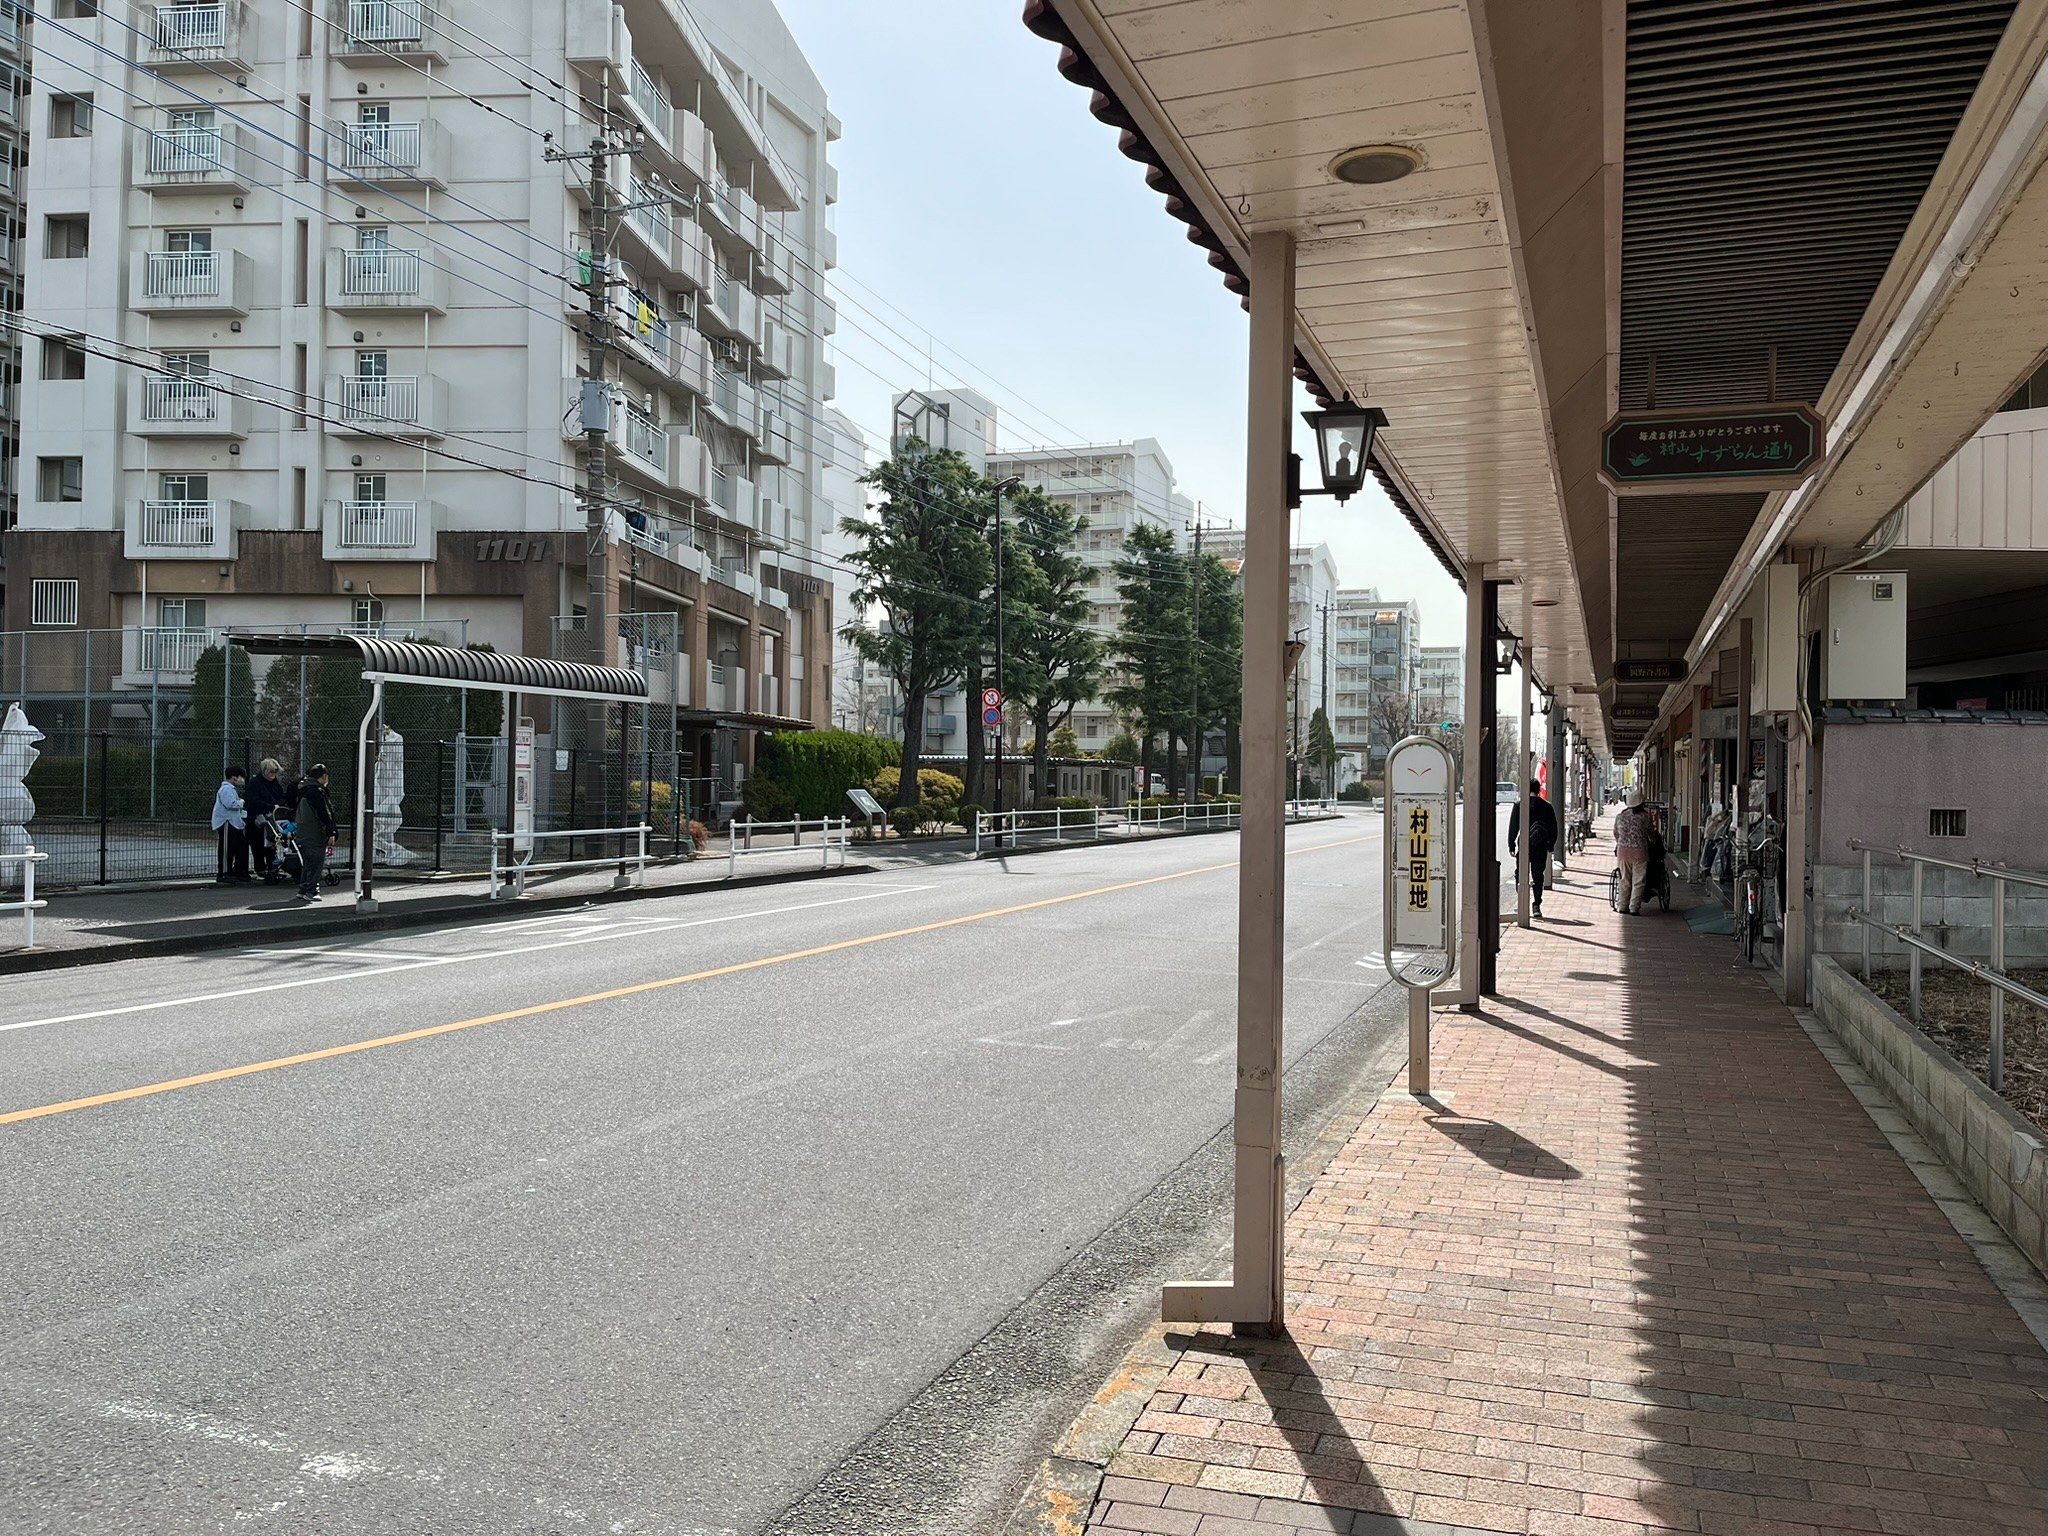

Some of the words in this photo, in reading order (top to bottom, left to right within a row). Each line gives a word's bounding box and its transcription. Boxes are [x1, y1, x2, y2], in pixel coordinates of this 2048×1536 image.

[476, 539, 547, 562] 1101
[803, 579, 822, 594] 1101
[1410, 809, 1429, 908] 村山団地
